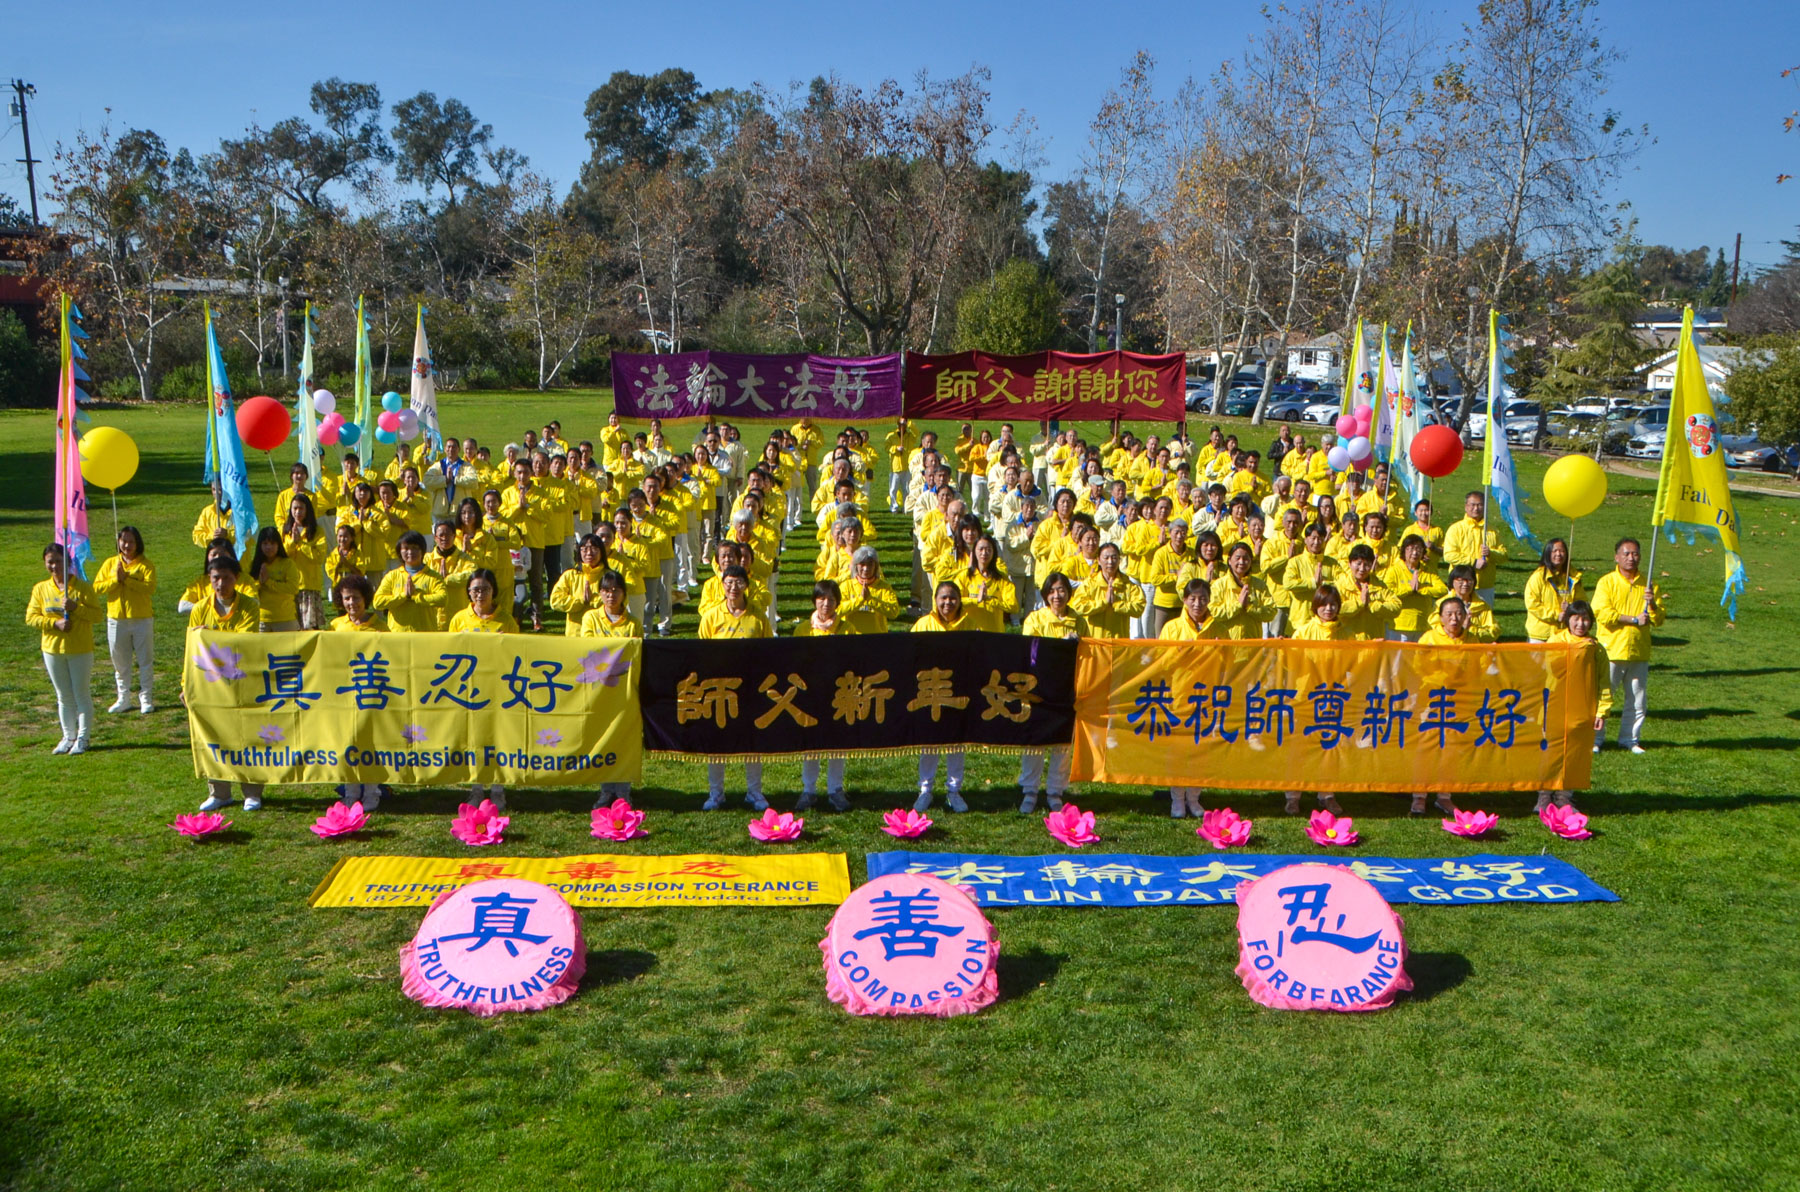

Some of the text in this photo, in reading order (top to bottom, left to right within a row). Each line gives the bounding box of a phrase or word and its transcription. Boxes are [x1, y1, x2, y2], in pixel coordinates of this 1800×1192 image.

[634, 361, 871, 412] 法輪大法好
[676, 666, 1044, 730] 師父新年好
[207, 743, 617, 772] Truthfulness Compassion Forbearance
[692, 880, 819, 893] TOLERANCE
[437, 891, 553, 957] 真
[852, 887, 965, 962] 善
[417, 937, 574, 1004] TRUTHFULNESS
[838, 938, 988, 1009] COMPASSION
